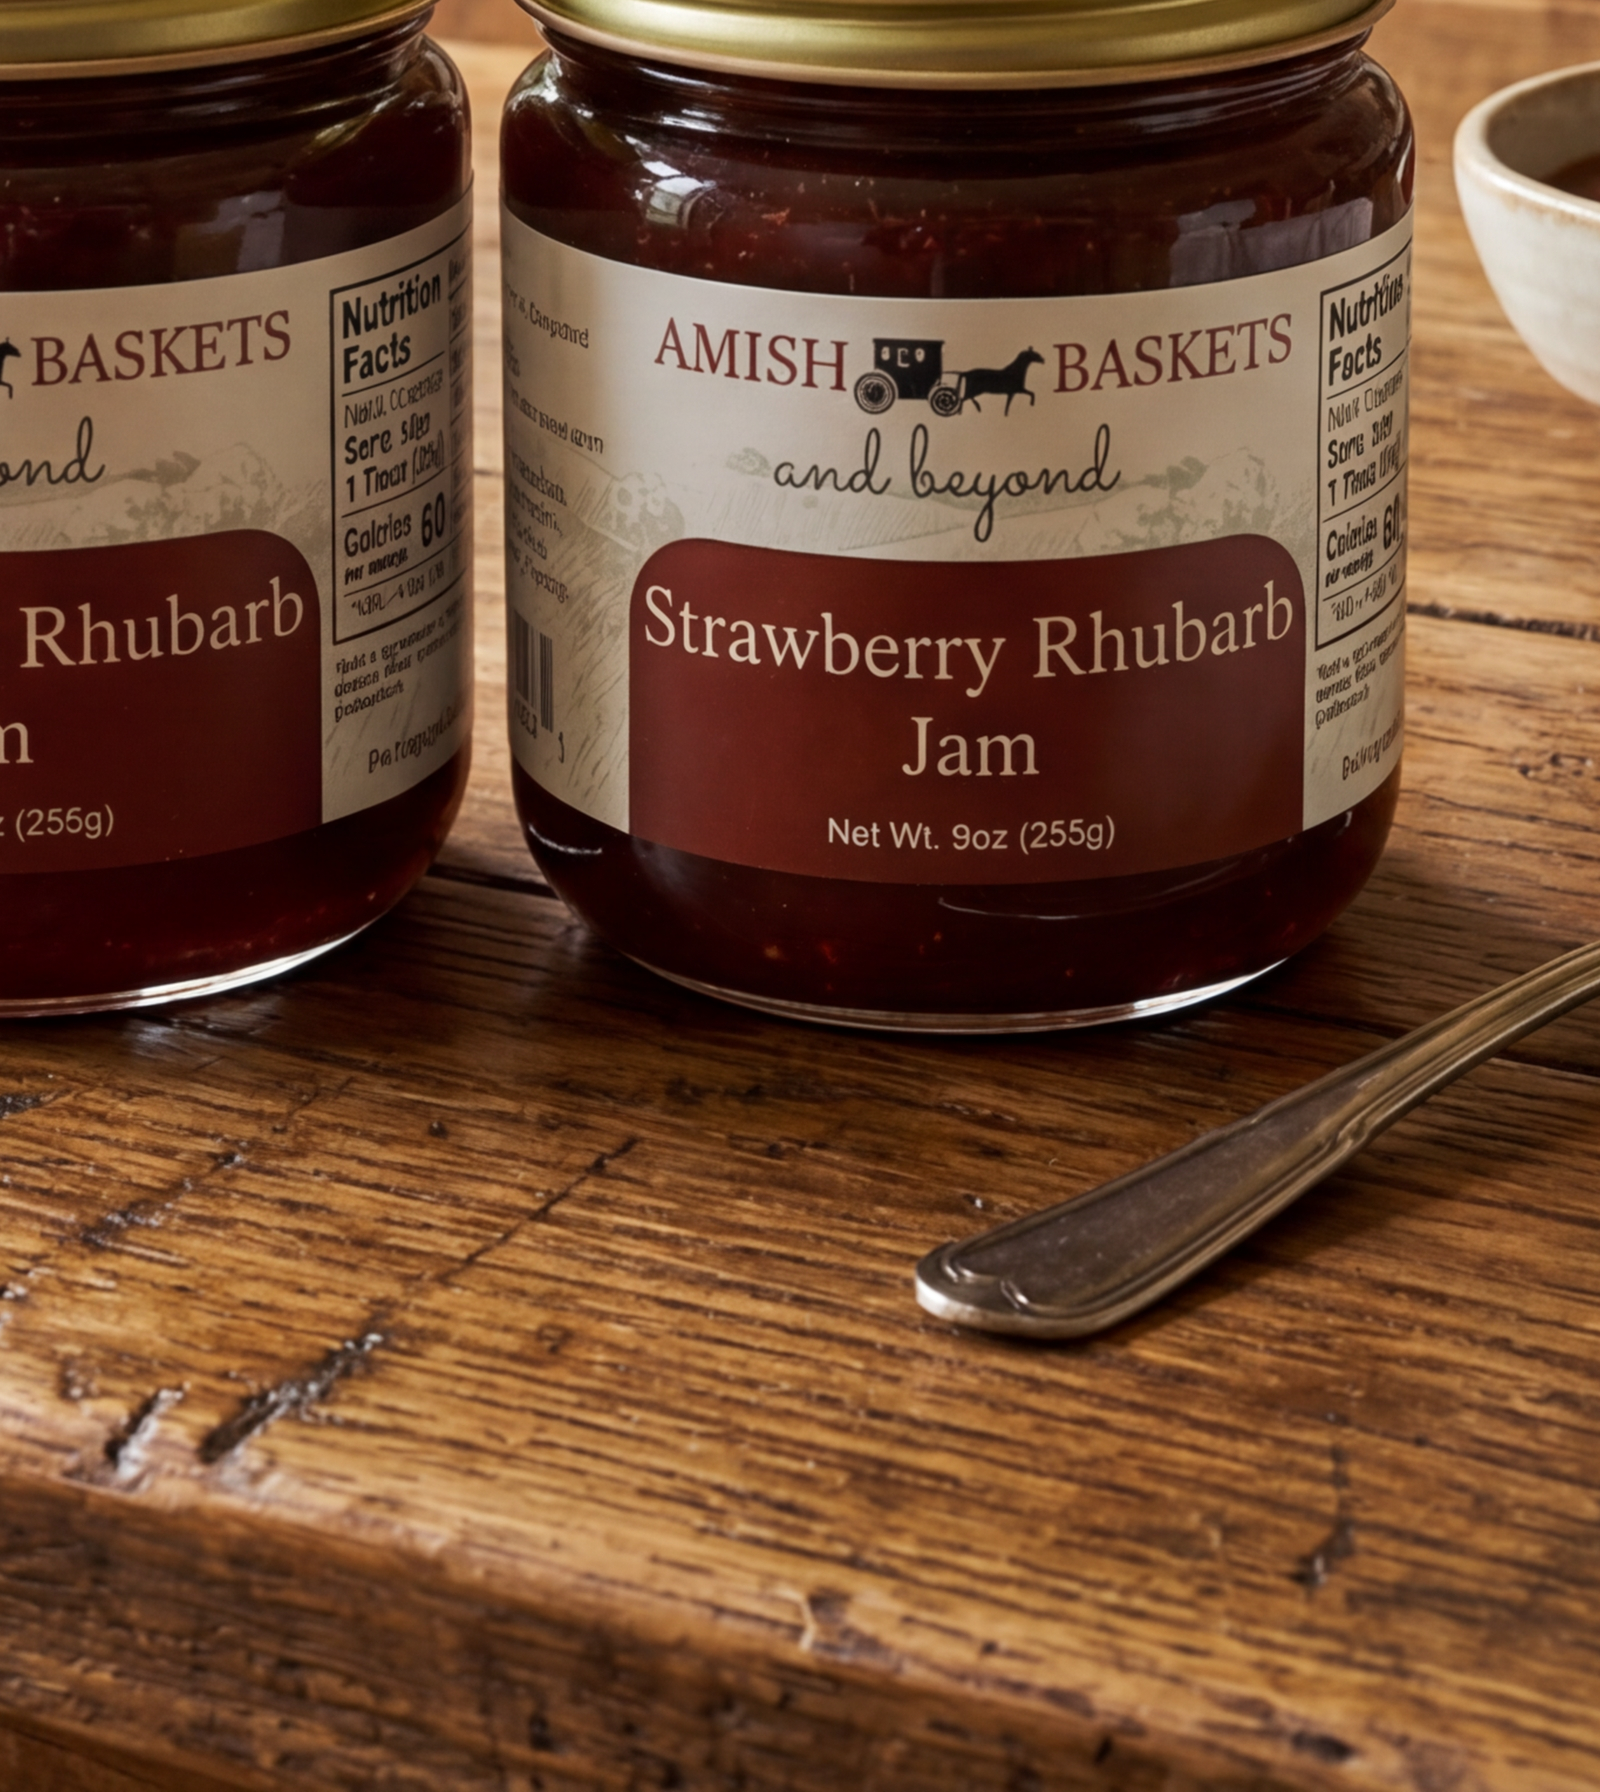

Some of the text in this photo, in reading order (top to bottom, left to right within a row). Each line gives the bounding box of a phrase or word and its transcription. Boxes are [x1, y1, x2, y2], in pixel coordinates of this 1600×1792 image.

[342, 273, 441, 339] Nutrition
[30, 310, 292, 387] BASKETS
[343, 331, 411, 384] Facts
[654, 313, 1293, 394] AMISH BASKETS
[773, 423, 1122, 543] and beyond
[421, 492, 445, 548] 60
[19, 576, 305, 668] Rhubarb
[644, 585, 1007, 698] Strawberry
[1032, 579, 1294, 678] Rhubarb
[901, 716, 1041, 776] Jam
[827, 815, 1116, 855] Net Wt. 9oz (255g)
